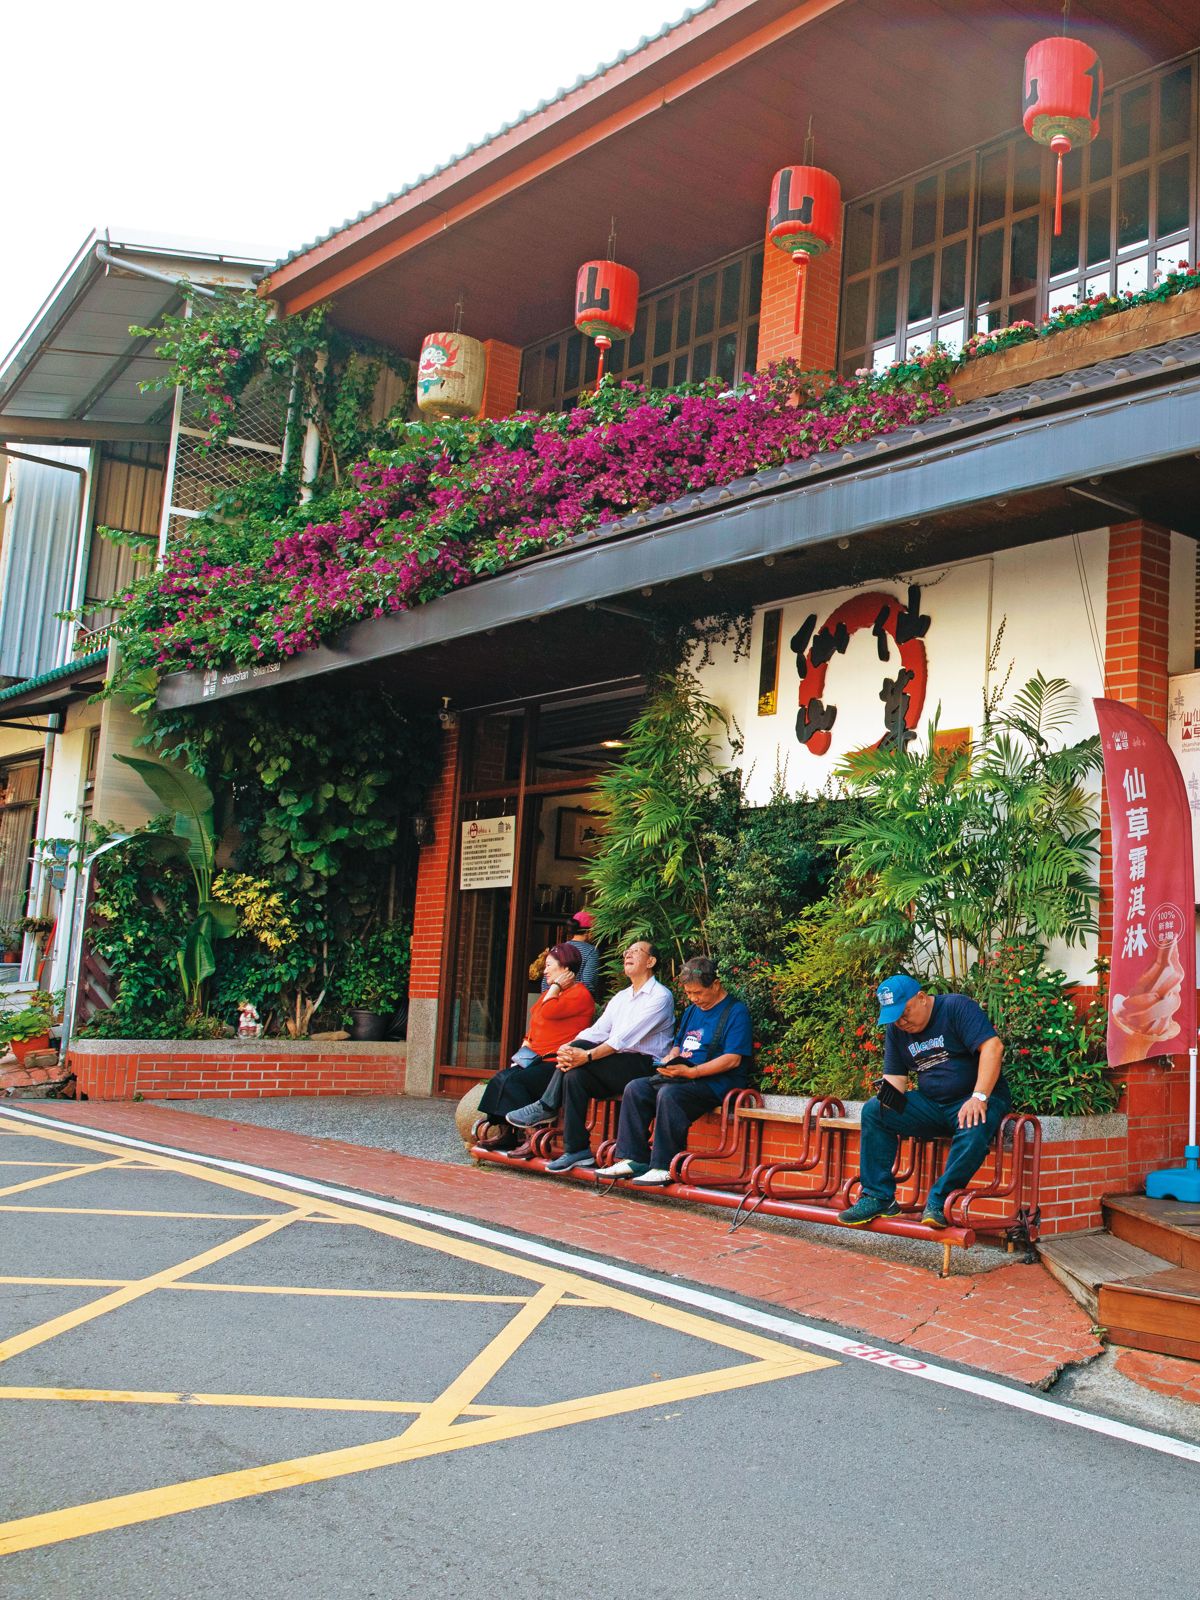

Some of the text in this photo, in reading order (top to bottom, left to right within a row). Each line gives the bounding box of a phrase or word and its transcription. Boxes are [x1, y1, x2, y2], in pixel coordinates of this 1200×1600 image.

[1121, 767, 1151, 960] 仙草霜淇淋
[1157, 910, 1176, 920] 100%
